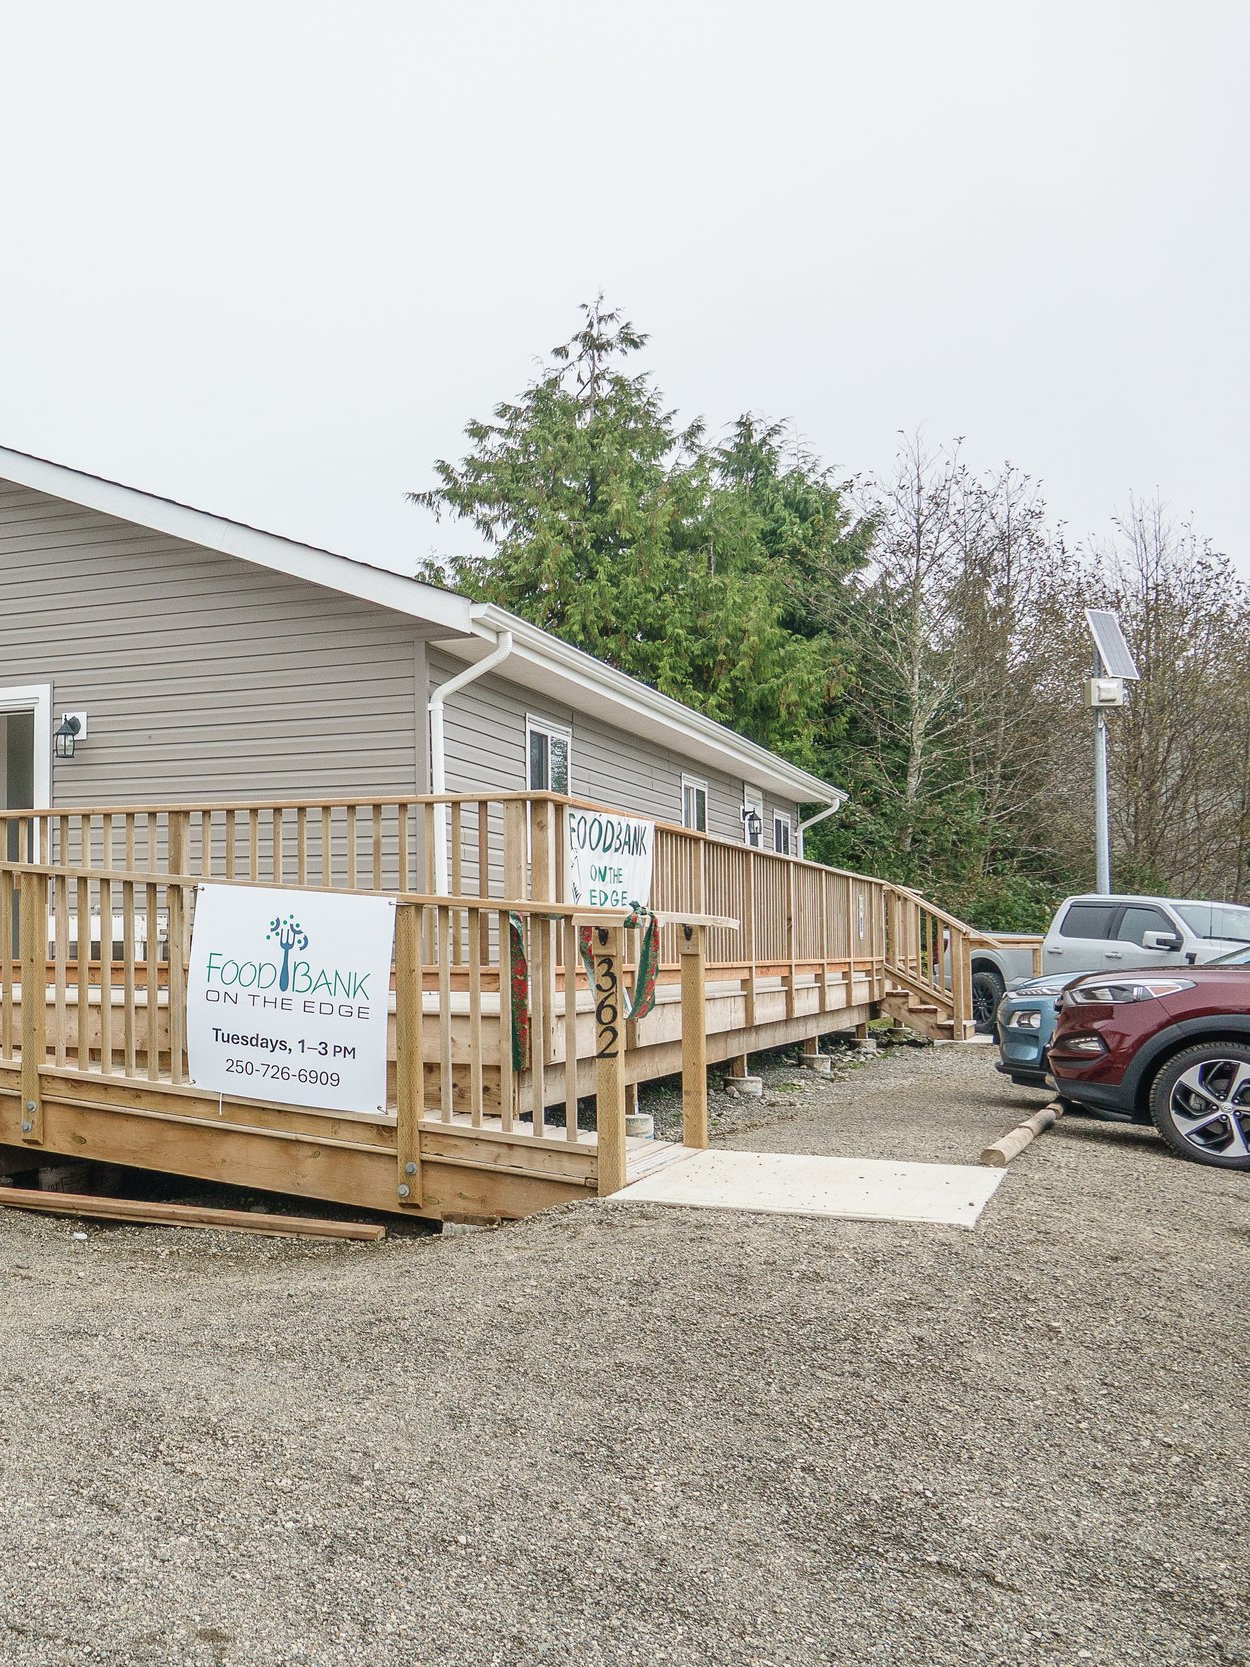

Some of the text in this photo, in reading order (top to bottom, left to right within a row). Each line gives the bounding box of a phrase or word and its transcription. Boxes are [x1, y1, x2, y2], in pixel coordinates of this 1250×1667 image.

[590, 864, 623, 885] ON THE
[589, 889, 628, 907] EDGE
[205, 989, 370, 1020] ON THE EDGE
[595, 957, 619, 1059] 362
[212, 1027, 292, 1055] Tuesdays,
[333, 1044, 356, 1060] PM
[225, 1058, 341, 1088] 250-726-6909
